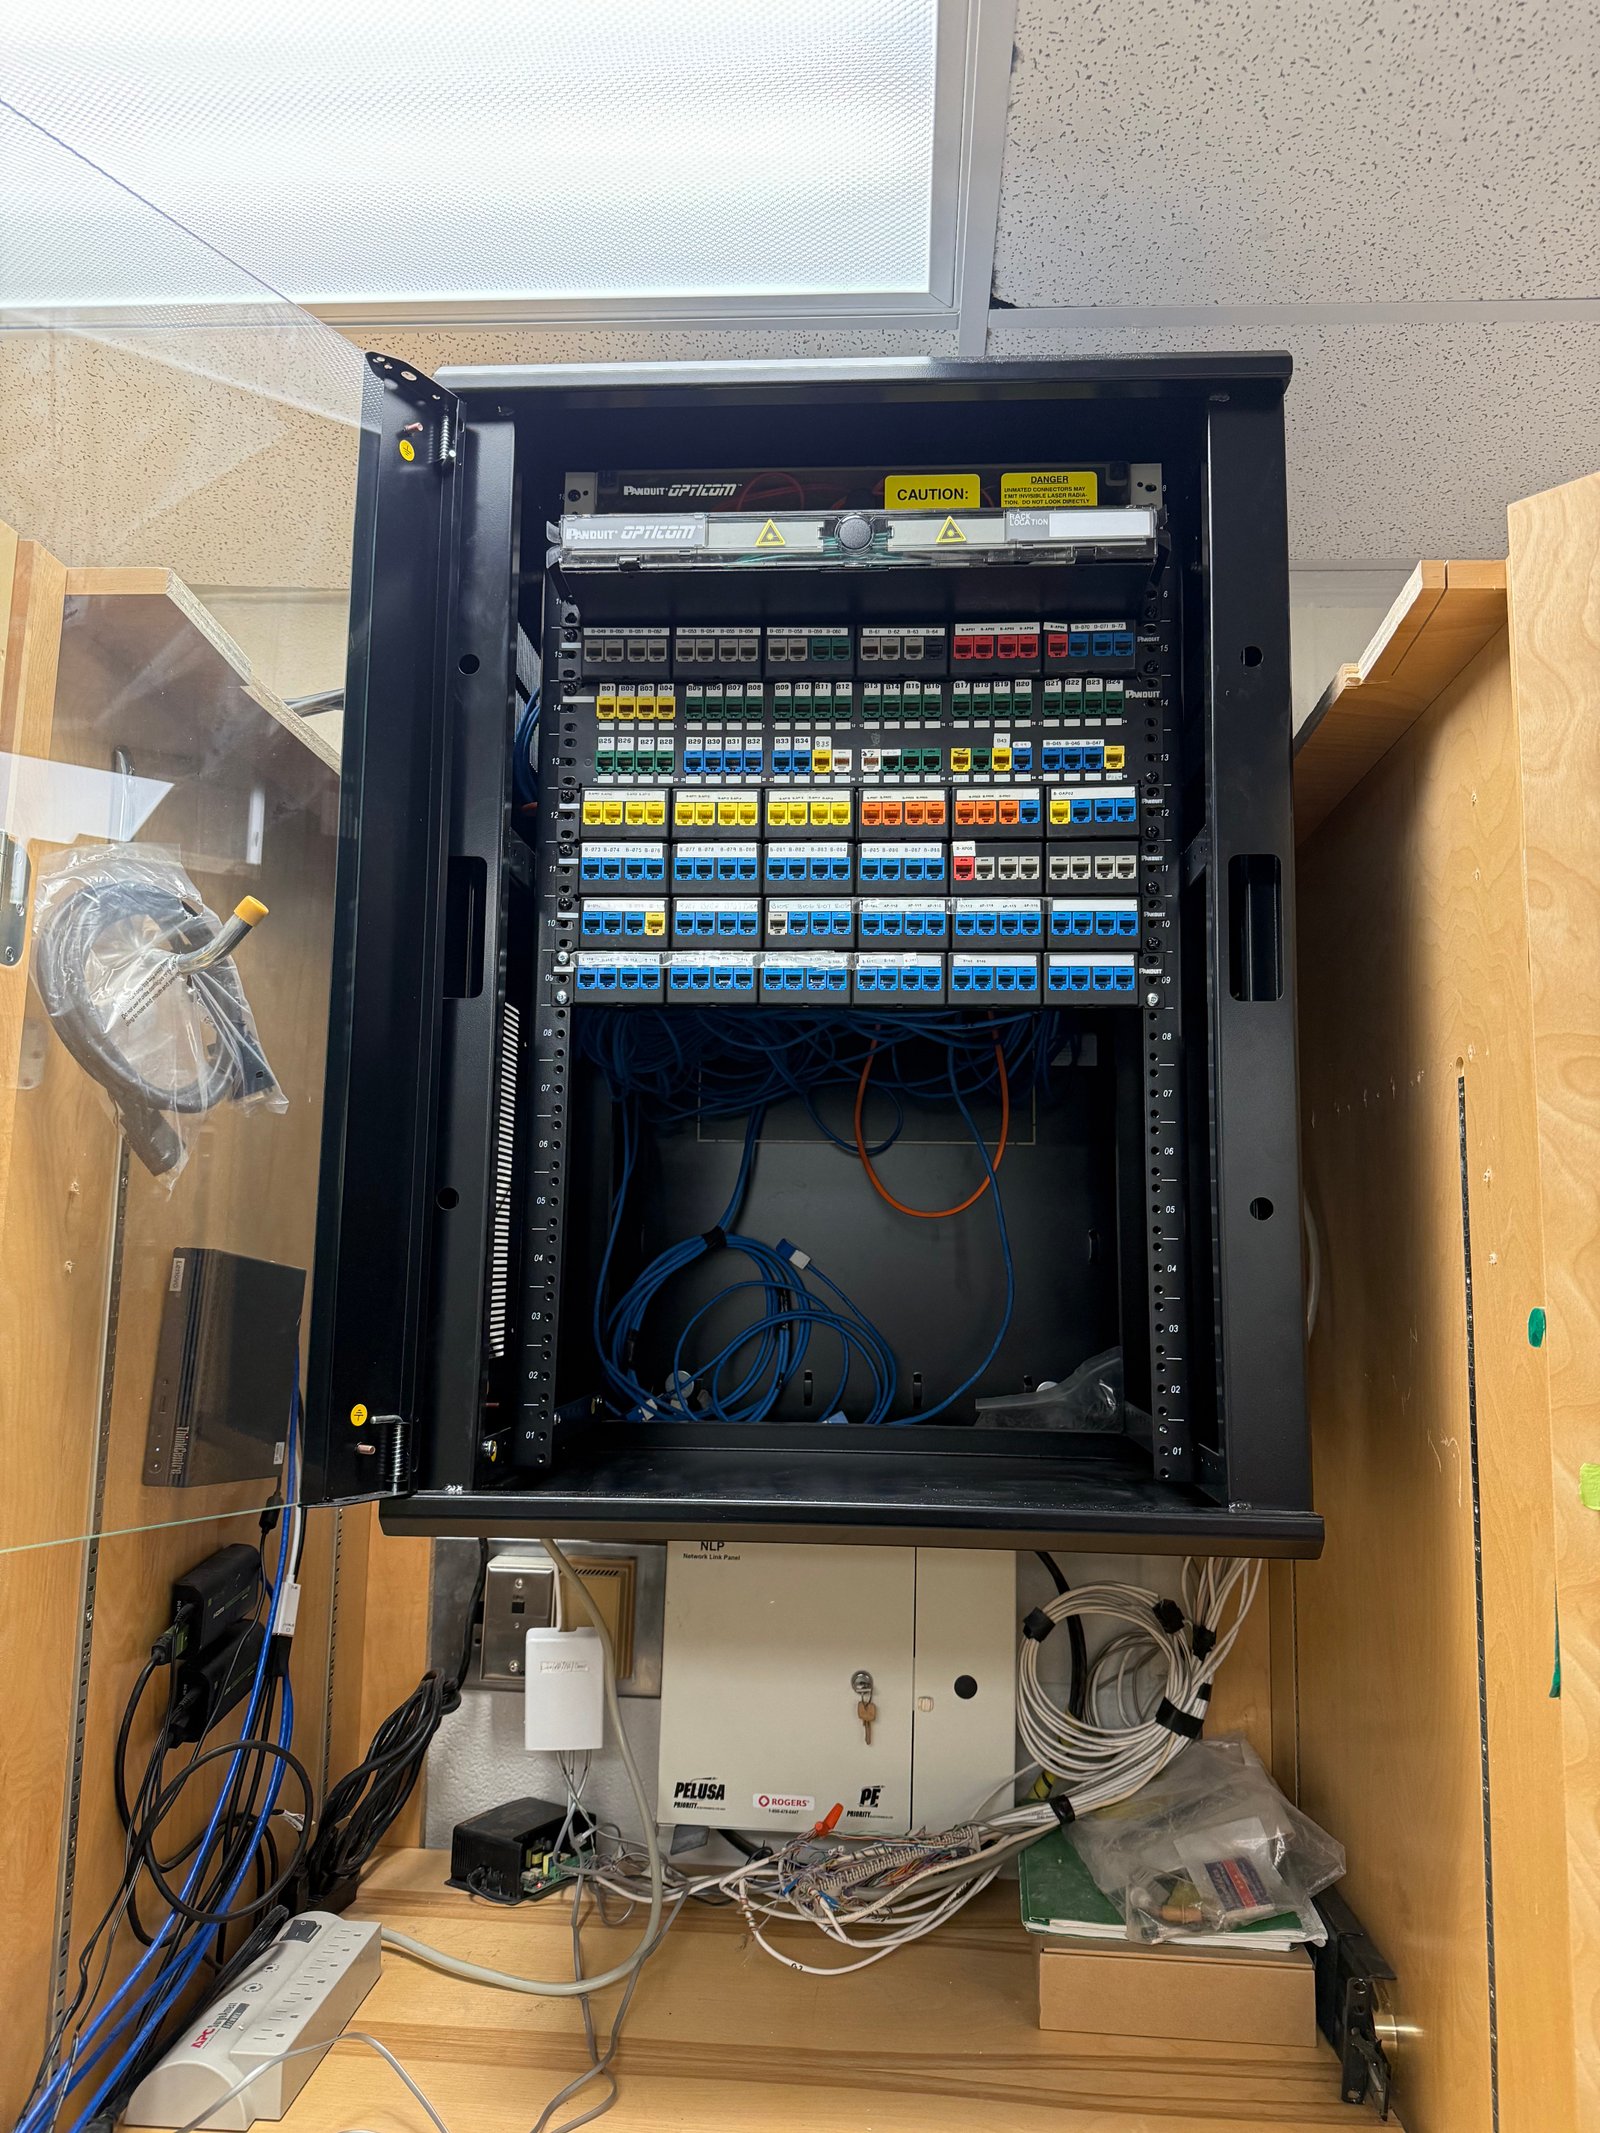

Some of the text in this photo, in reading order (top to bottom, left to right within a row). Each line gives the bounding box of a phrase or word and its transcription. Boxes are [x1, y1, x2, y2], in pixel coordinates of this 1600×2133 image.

[1030, 475, 1069, 484] DANGER
[624, 485, 665, 496] PANDUIT
[897, 488, 969, 501] CAUTION:
[565, 527, 615, 540] PANDUIT
[1125, 690, 1160, 699] PANDUIT
[1162, 1032, 1172, 1040] 08
[1164, 1147, 1174, 1155] 06
[536, 1196, 546, 1205] 05
[1166, 1206, 1175, 1214] 05
[1167, 1264, 1176, 1272] 04
[172, 1260, 182, 1289] Lenovo
[1169, 1324, 1179, 1332] 03
[1171, 1385, 1180, 1394] 02
[171, 1426, 190, 1475] ThinkCentre
[1172, 1447, 1182, 1455] 01
[700, 1541, 725, 1551] NLP
[674, 1782, 725, 1800] PELUSA
[673, 1801, 698, 1810] PRIORITY
[772, 1798, 807, 1807] ROGERS
[847, 1810, 871, 1819] PRIORITY
[190, 2028, 216, 2049] APC
